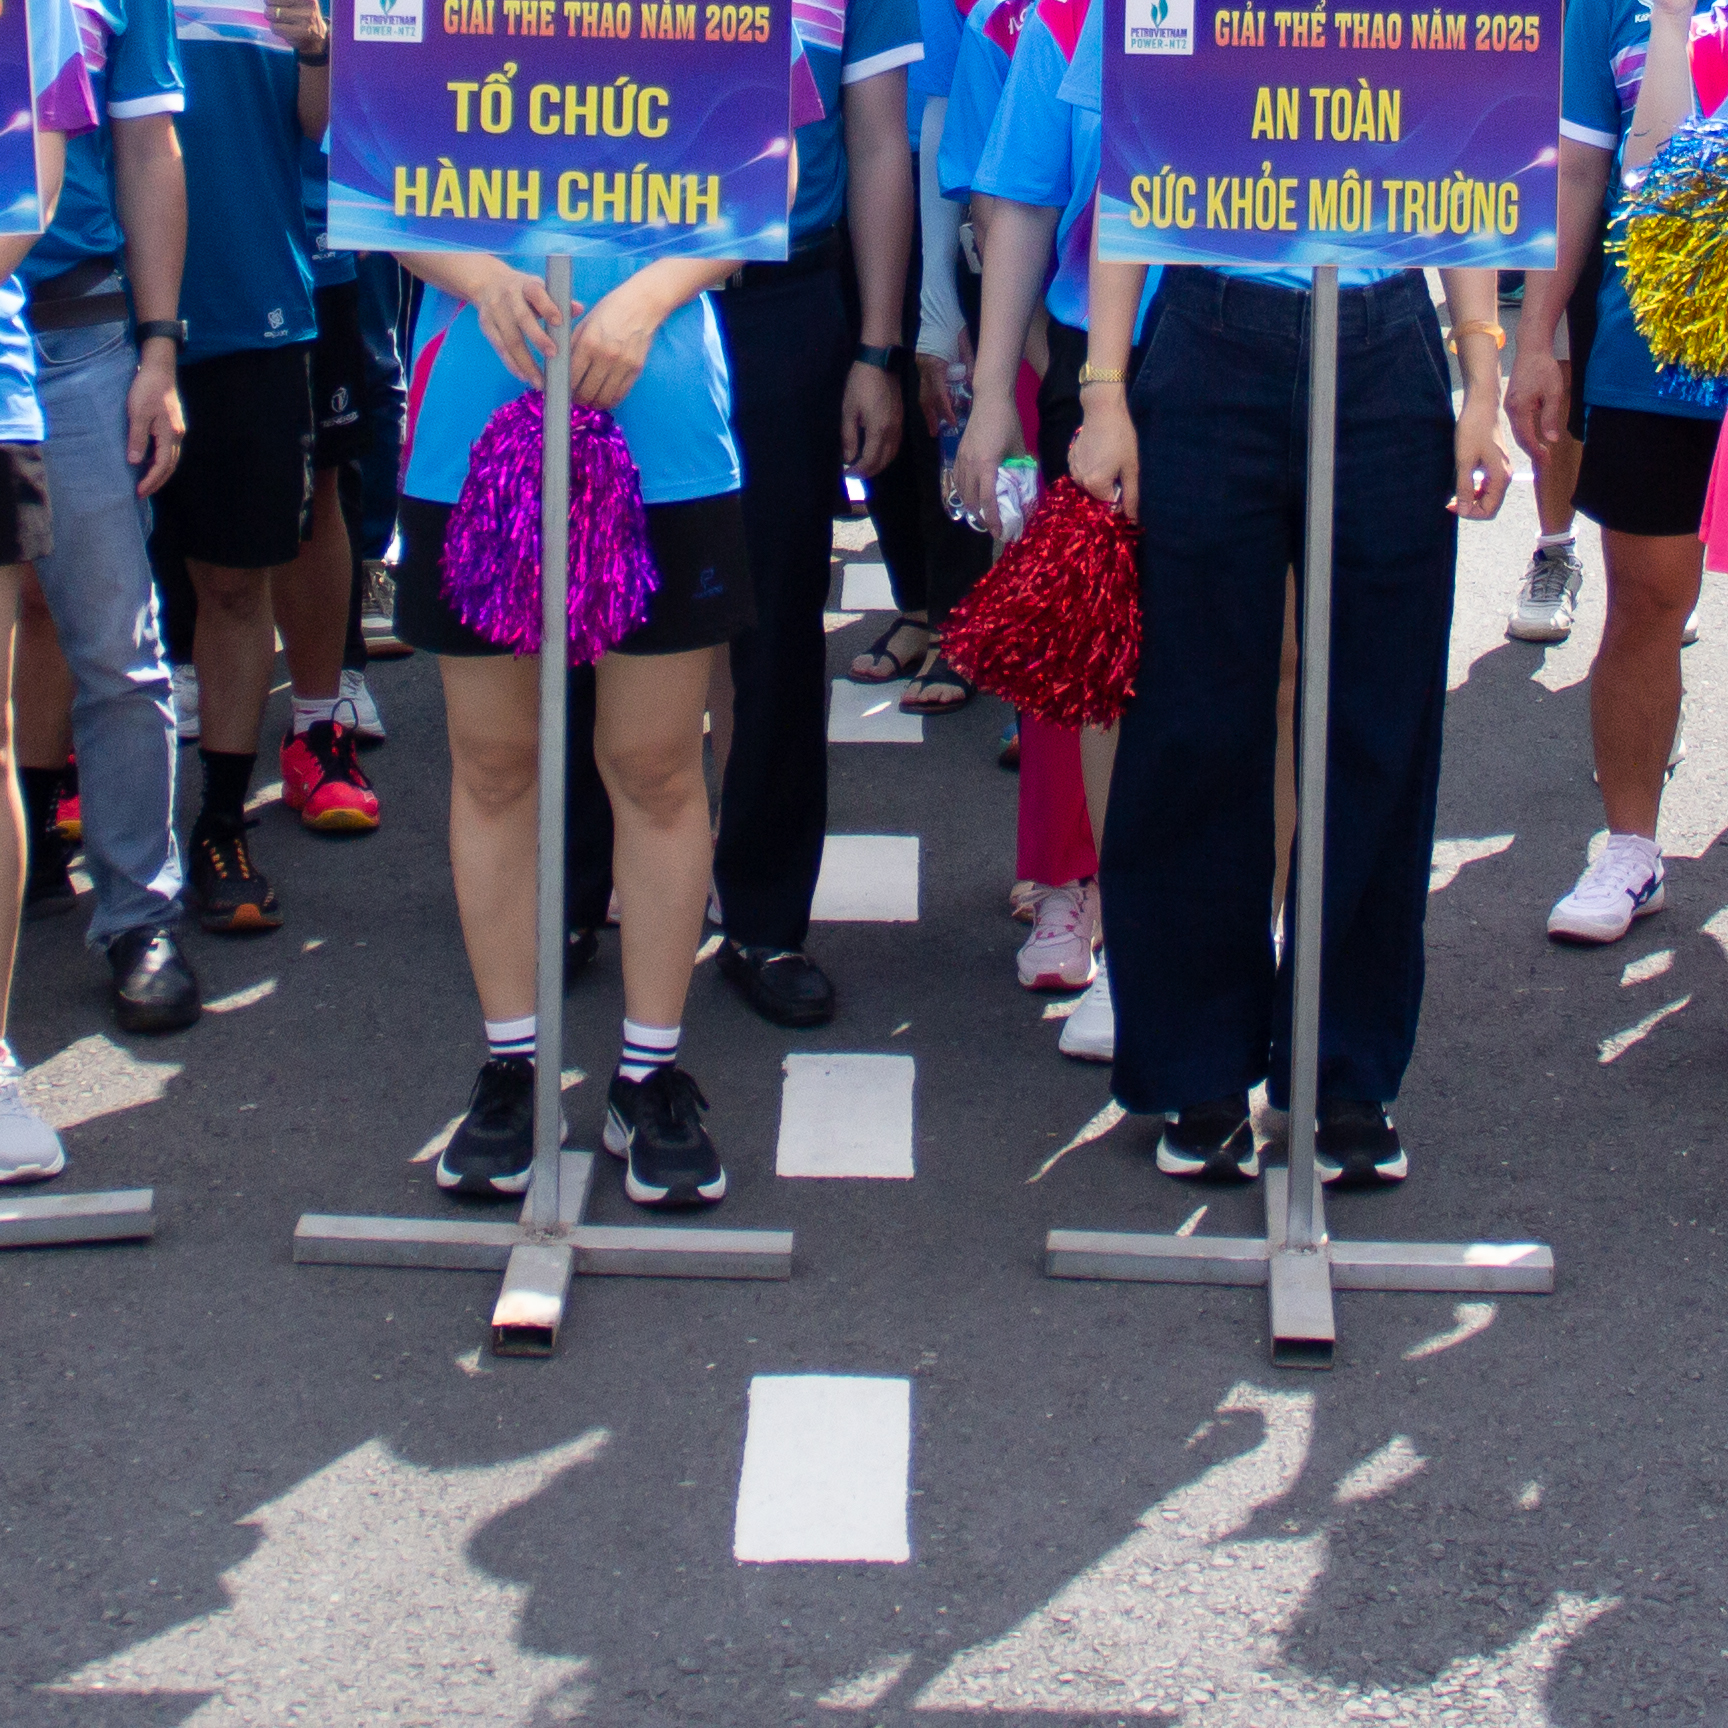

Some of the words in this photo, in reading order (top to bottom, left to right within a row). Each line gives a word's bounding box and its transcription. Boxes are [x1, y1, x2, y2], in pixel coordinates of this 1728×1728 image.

[564, 2, 631, 39] THAO
[705, 5, 769, 43] 2025
[1214, 1, 1265, 47] GIẢI
[1275, 0, 1327, 47] THỂ
[1335, 12, 1402, 49] THAO
[1411, 8, 1466, 51] NĂM
[1475, 15, 1539, 52] 2025
[447, 63, 517, 134] TỔ
[529, 77, 669, 137] CHỨC
[1251, 87, 1298, 140] AN
[1310, 78, 1401, 142] TOÀN
[394, 158, 540, 220] HÀNH
[557, 163, 719, 224] CHÍNH
[1130, 166, 1196, 229] SỨC
[1206, 162, 1298, 231] KHỎE
[1309, 169, 1372, 231] MÔI
[1383, 171, 1518, 235] TRƯỜNG
